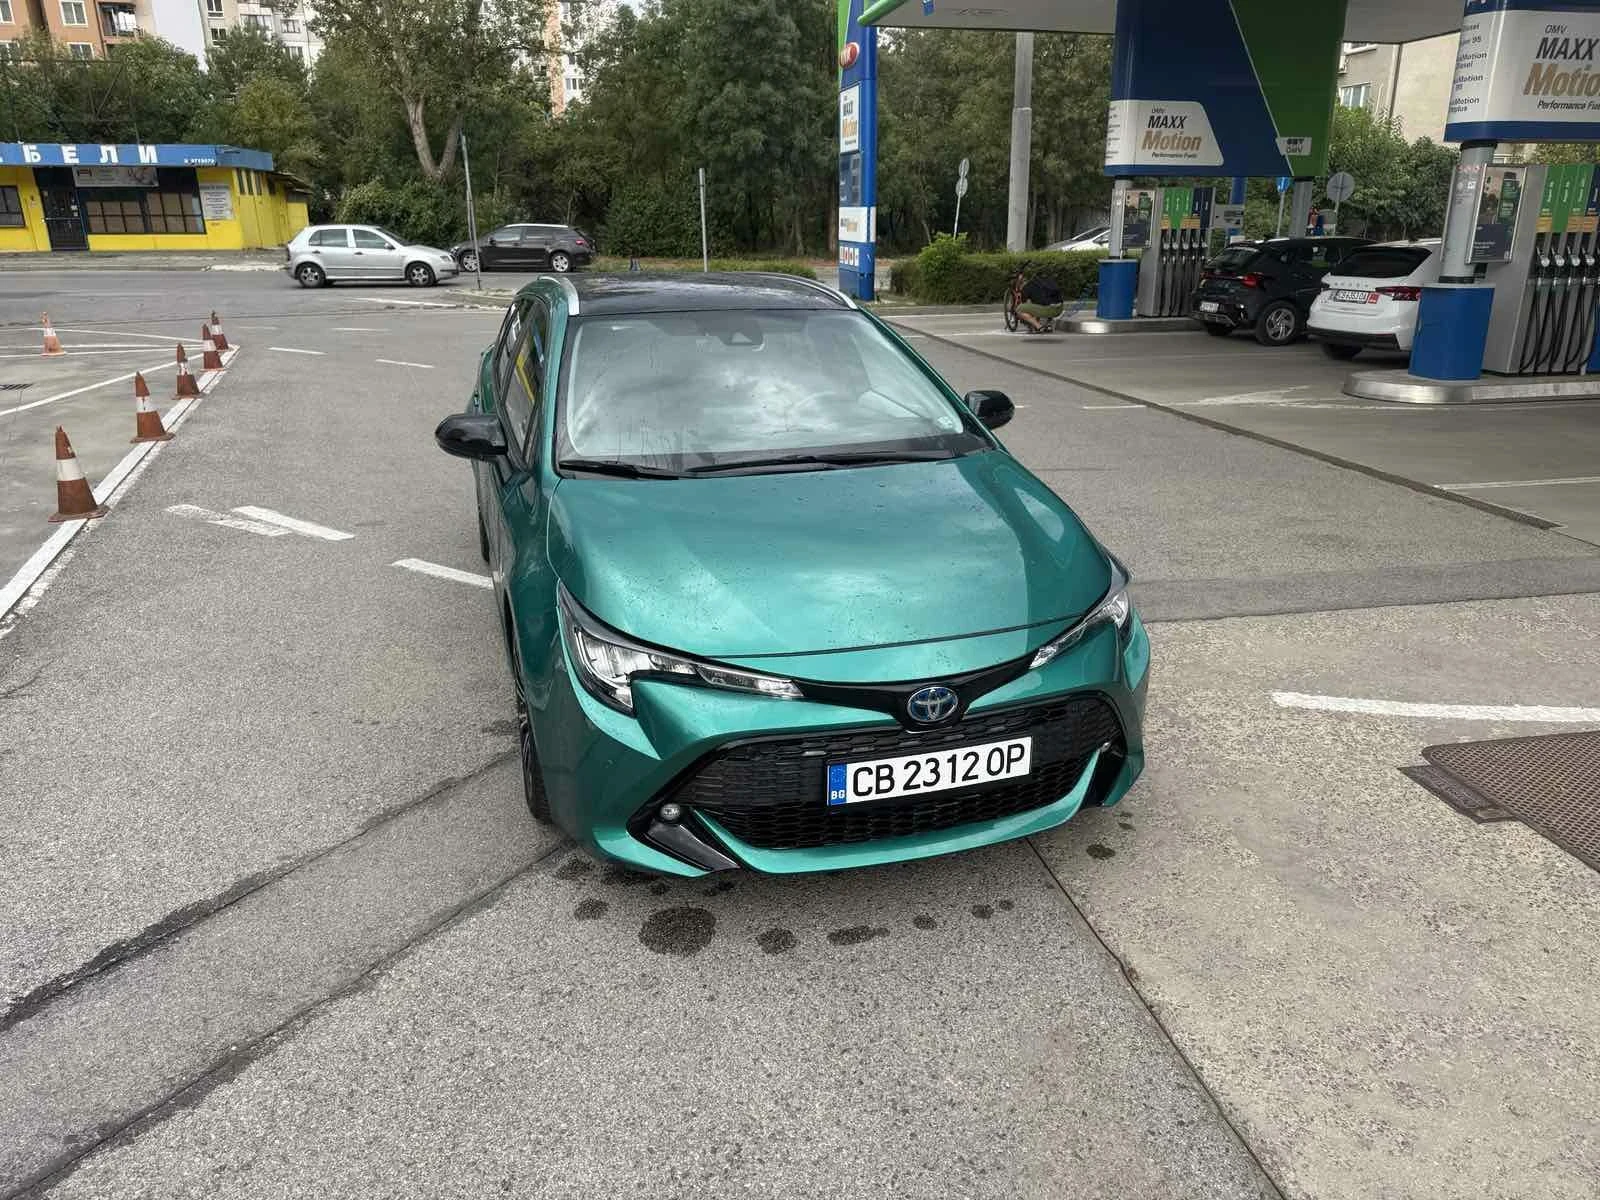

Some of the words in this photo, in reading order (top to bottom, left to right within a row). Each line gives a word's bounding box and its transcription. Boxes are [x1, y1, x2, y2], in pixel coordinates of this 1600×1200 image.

[1545, 25, 1567, 34] OMV
[1536, 37, 1600, 60] MAXX
[1523, 63, 1600, 96] Motio
[1148, 115, 1187, 128] MAXX
[1142, 130, 1201, 150] Motion
[0, 144, 158, 163] БЕЛИ
[852, 764, 895, 797] CB
[903, 752, 980, 791] 2312
[986, 743, 1025, 776] OP
[830, 789, 845, 800] BG
